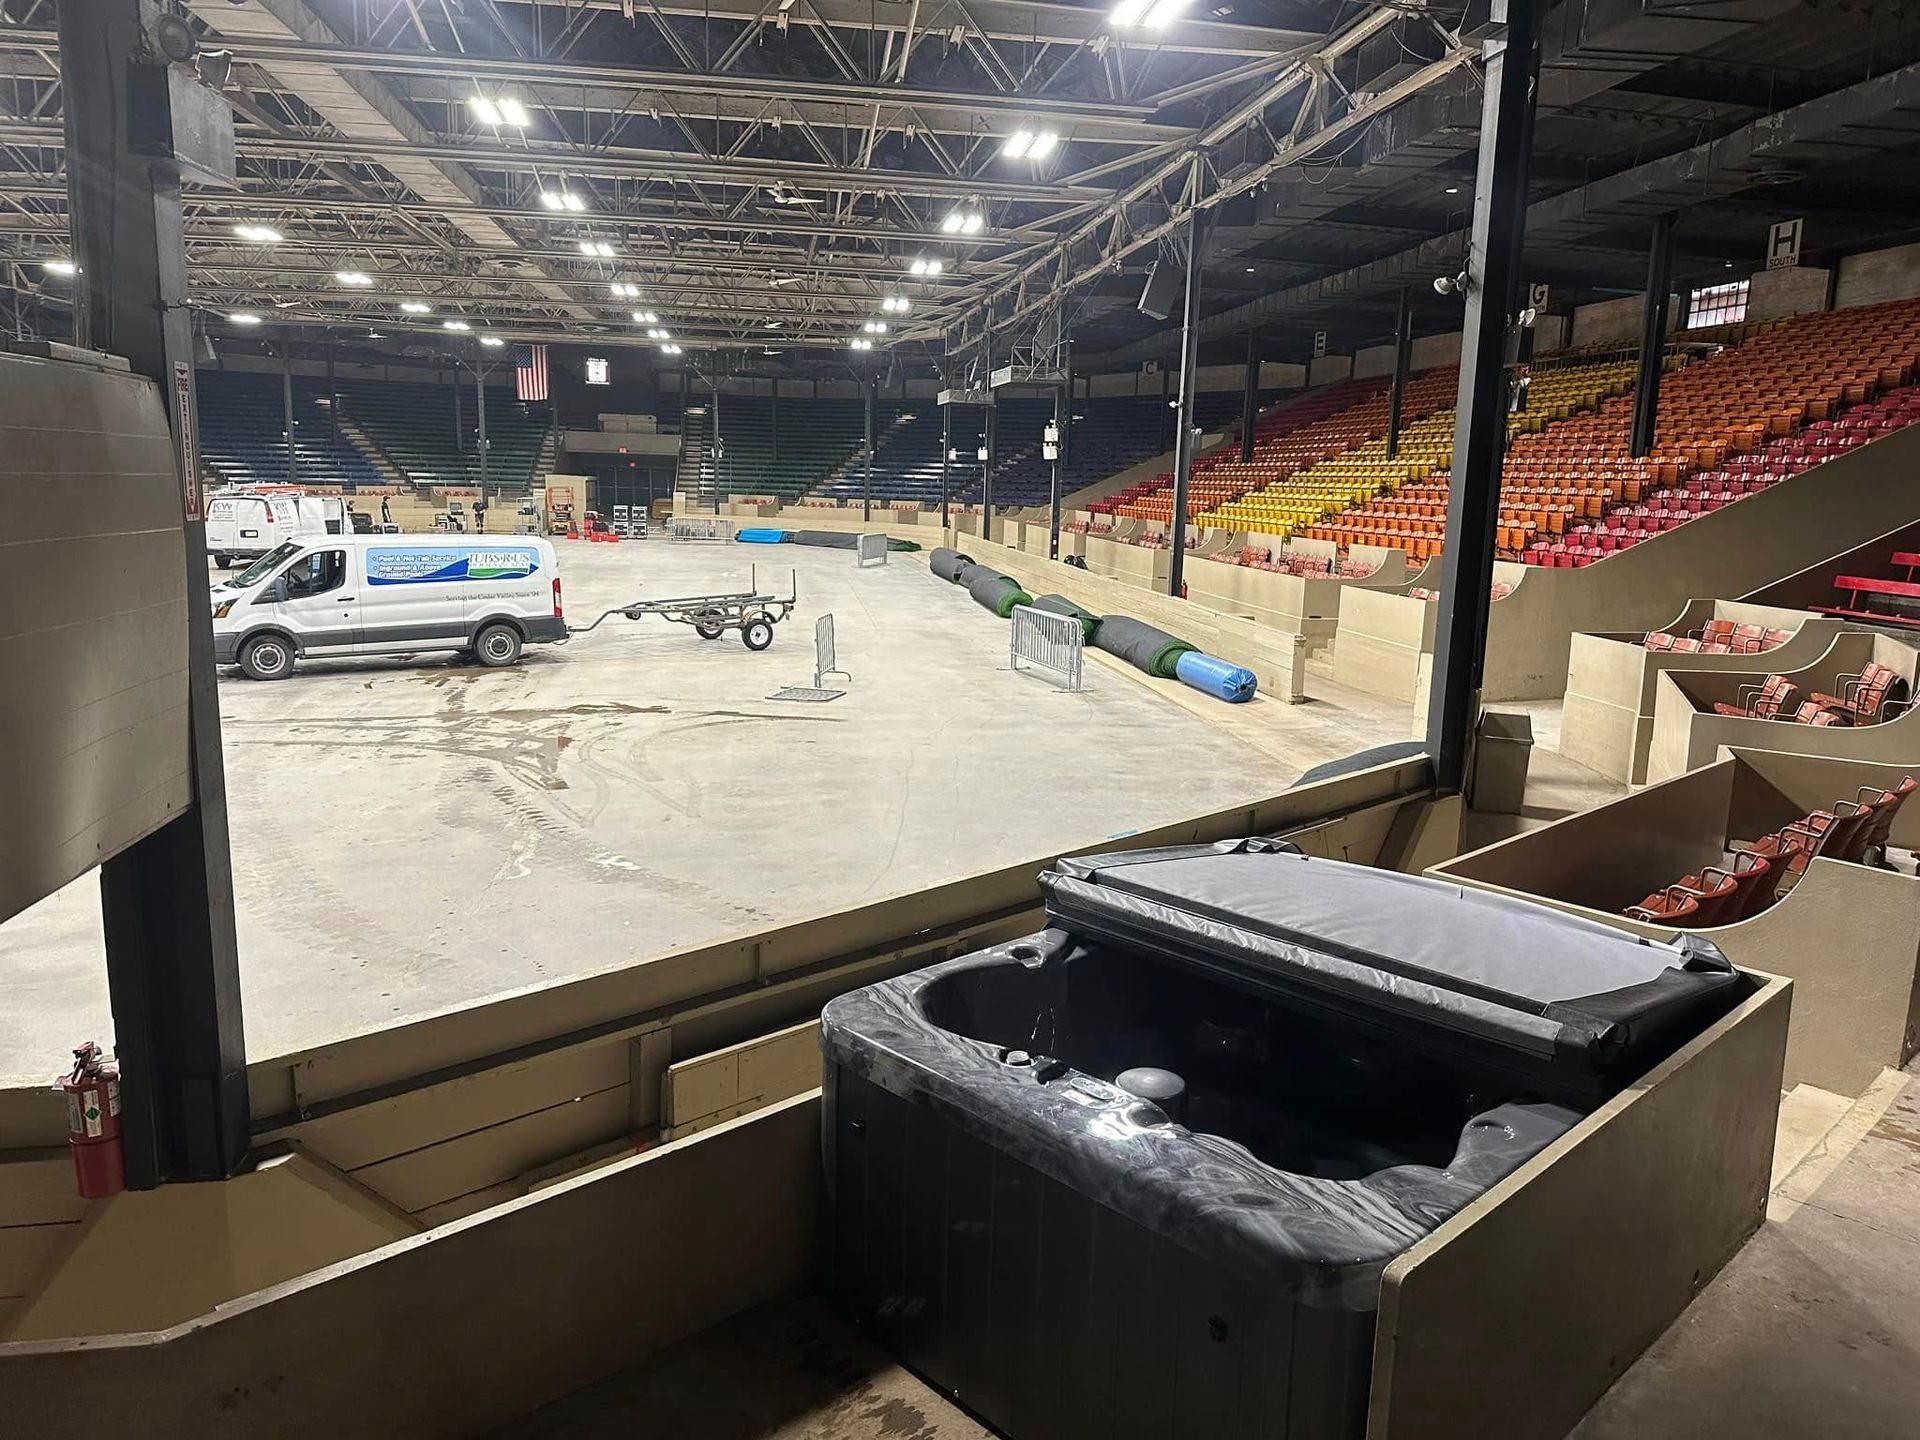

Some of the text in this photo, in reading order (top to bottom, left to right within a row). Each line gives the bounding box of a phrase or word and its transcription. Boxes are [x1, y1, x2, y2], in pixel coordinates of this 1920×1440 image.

[1772, 221, 1798, 257] H
[1769, 255, 1796, 268] SOUTH
[1532, 283, 1546, 305] G
[1316, 332, 1325, 350] E
[1145, 361, 1155, 375] C
